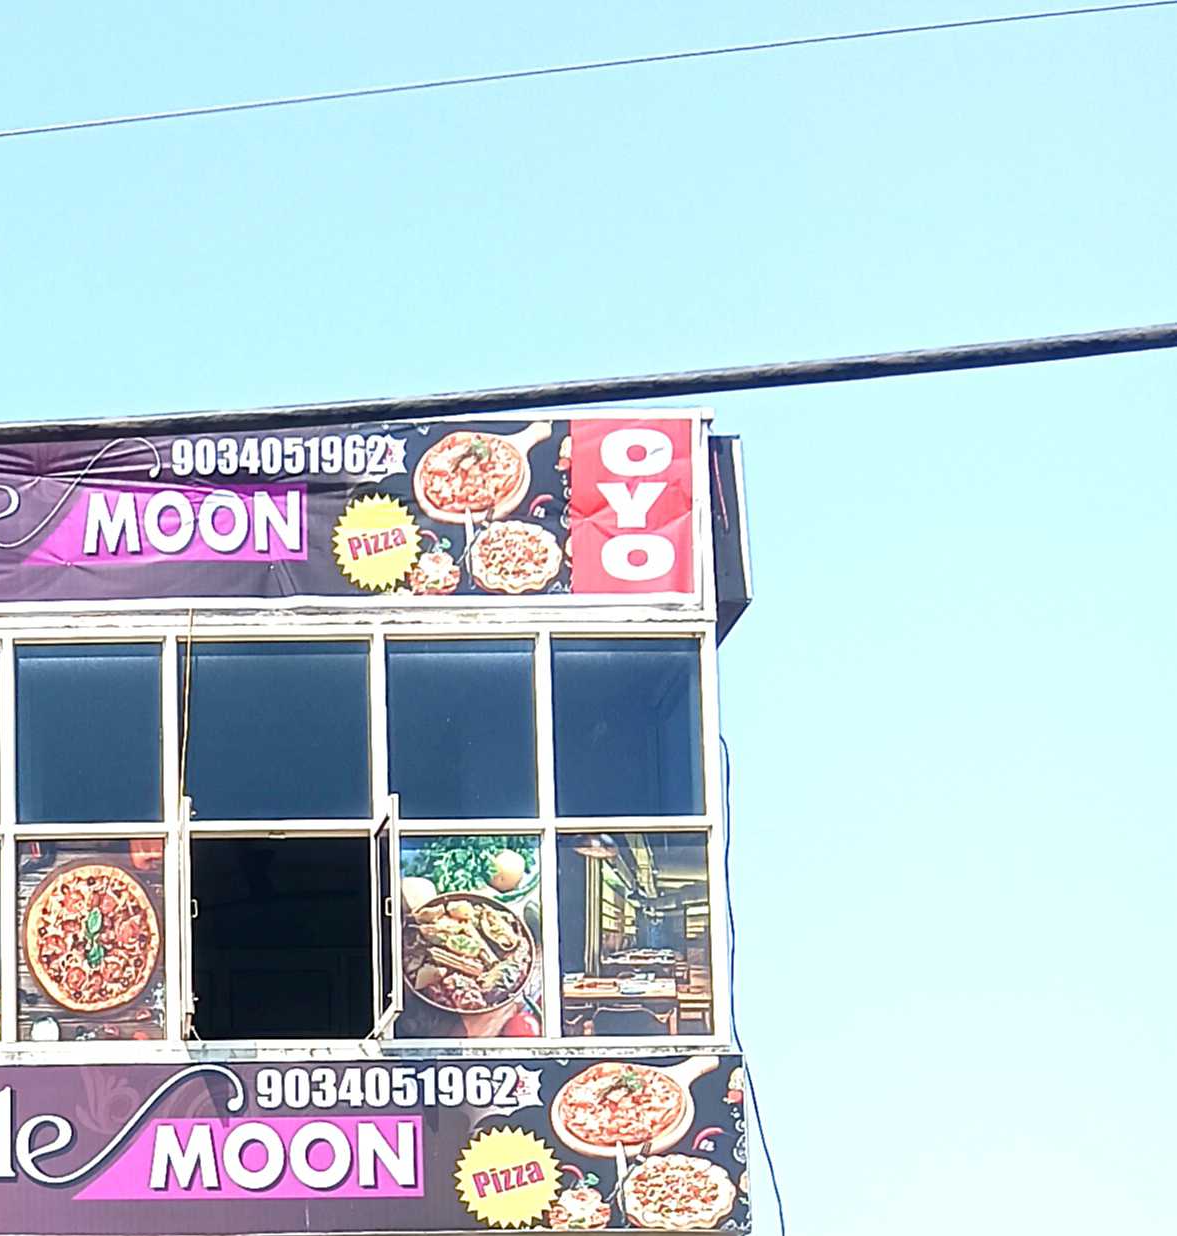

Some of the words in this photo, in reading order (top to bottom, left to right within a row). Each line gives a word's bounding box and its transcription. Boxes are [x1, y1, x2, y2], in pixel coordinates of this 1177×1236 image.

[172, 434, 389, 476] 9034051962
[83, 488, 303, 555] MOON
[596, 428, 676, 581] OYO
[347, 525, 408, 561] Pizza
[255, 1066, 520, 1109] 9034051962
[149, 1120, 416, 1191] MOON
[472, 1158, 546, 1198] Pizza
